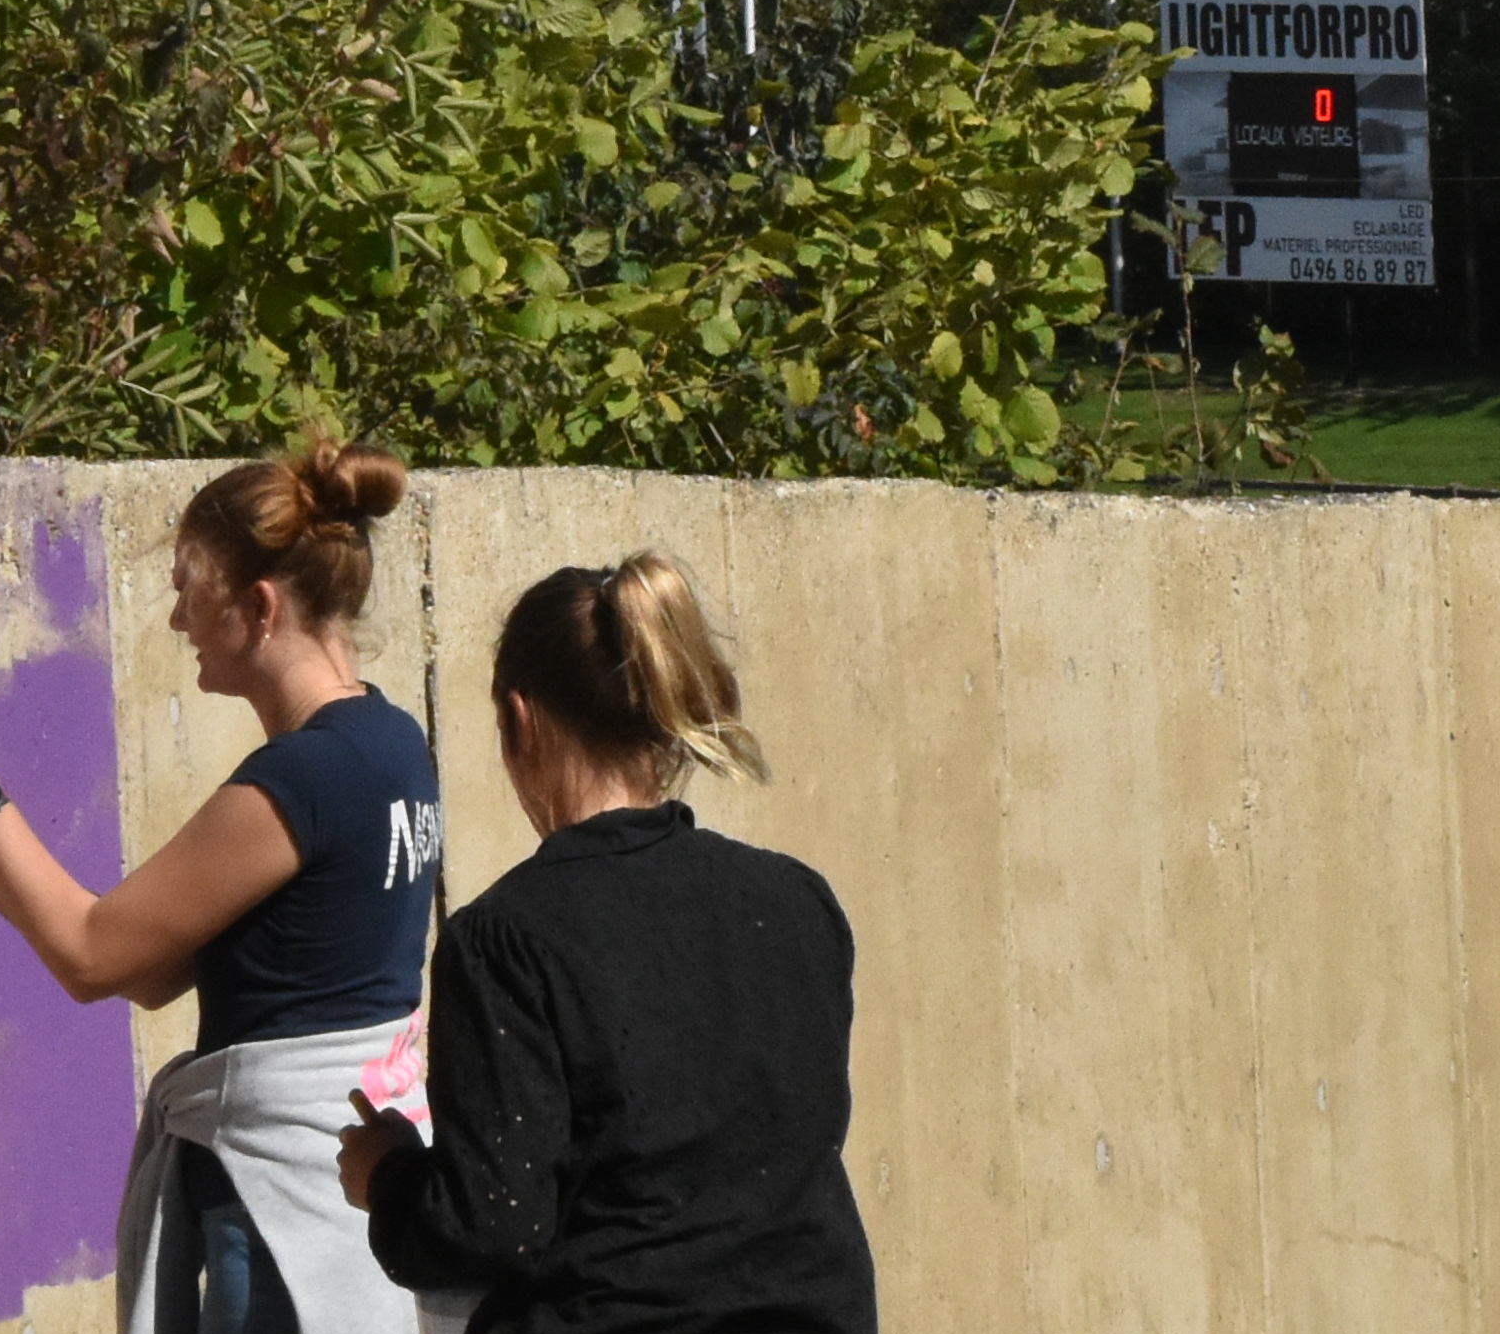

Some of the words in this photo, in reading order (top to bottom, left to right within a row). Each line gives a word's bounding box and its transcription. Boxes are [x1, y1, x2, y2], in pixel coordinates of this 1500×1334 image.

[1168, 2, 1419, 60] LIGHTFORPRO
[1315, 89, 1332, 122] 0
[1235, 125, 1285, 145] LOCAUX
[1293, 126, 1352, 147] VISITEURS
[1399, 204, 1424, 219] LED
[1325, 238, 1426, 256] PROFESSIONNEL
[1290, 257, 1336, 280] 0496
[1344, 258, 1367, 281] 86
[1374, 259, 1397, 283] 89
[1404, 260, 1426, 283] 87
